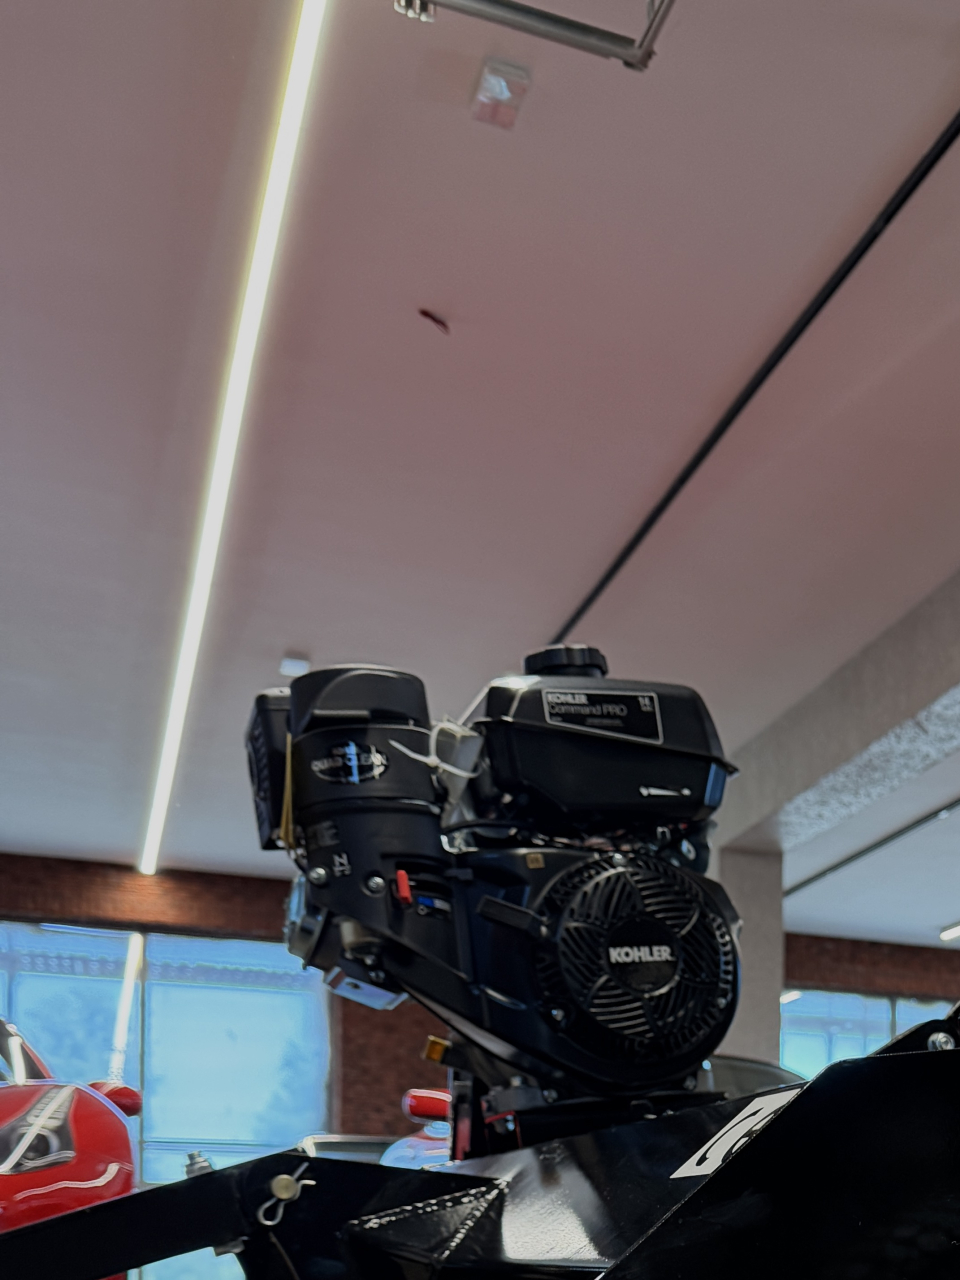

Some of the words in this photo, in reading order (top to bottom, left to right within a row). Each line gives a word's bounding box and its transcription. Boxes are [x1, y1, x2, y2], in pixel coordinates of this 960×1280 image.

[547, 693, 588, 704] KOHLER
[549, 703, 601, 716] Command
[602, 703, 628, 717] PRO
[608, 945, 672, 963] KOHLER
